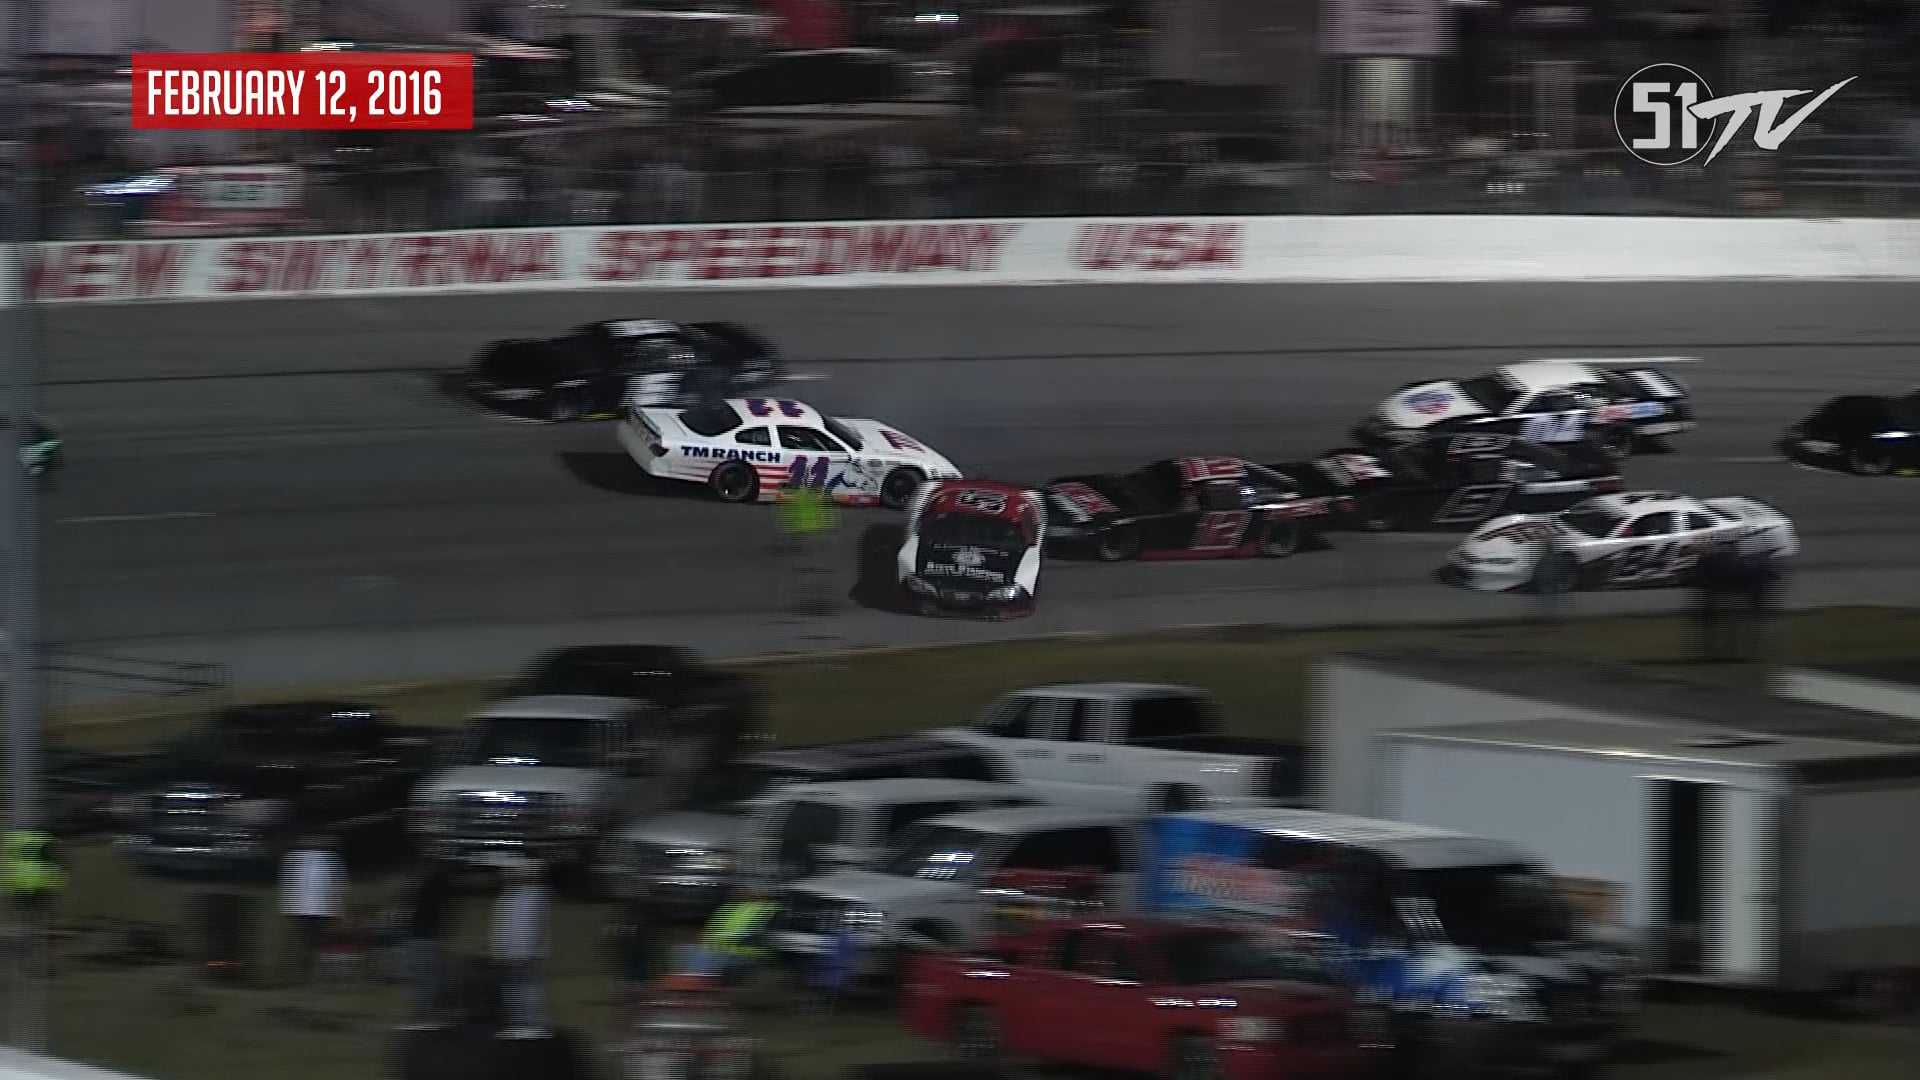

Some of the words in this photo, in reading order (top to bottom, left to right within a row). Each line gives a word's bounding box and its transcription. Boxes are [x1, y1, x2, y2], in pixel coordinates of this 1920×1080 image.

[208, 232, 560, 291] SMYRNA
[588, 223, 1025, 280] SPEEDWAY
[1070, 222, 1243, 270] USA
[681, 445, 711, 459] TM
[712, 447, 781, 464] RANCH
[787, 454, 831, 490] 11
[1189, 509, 1253, 550] 12
